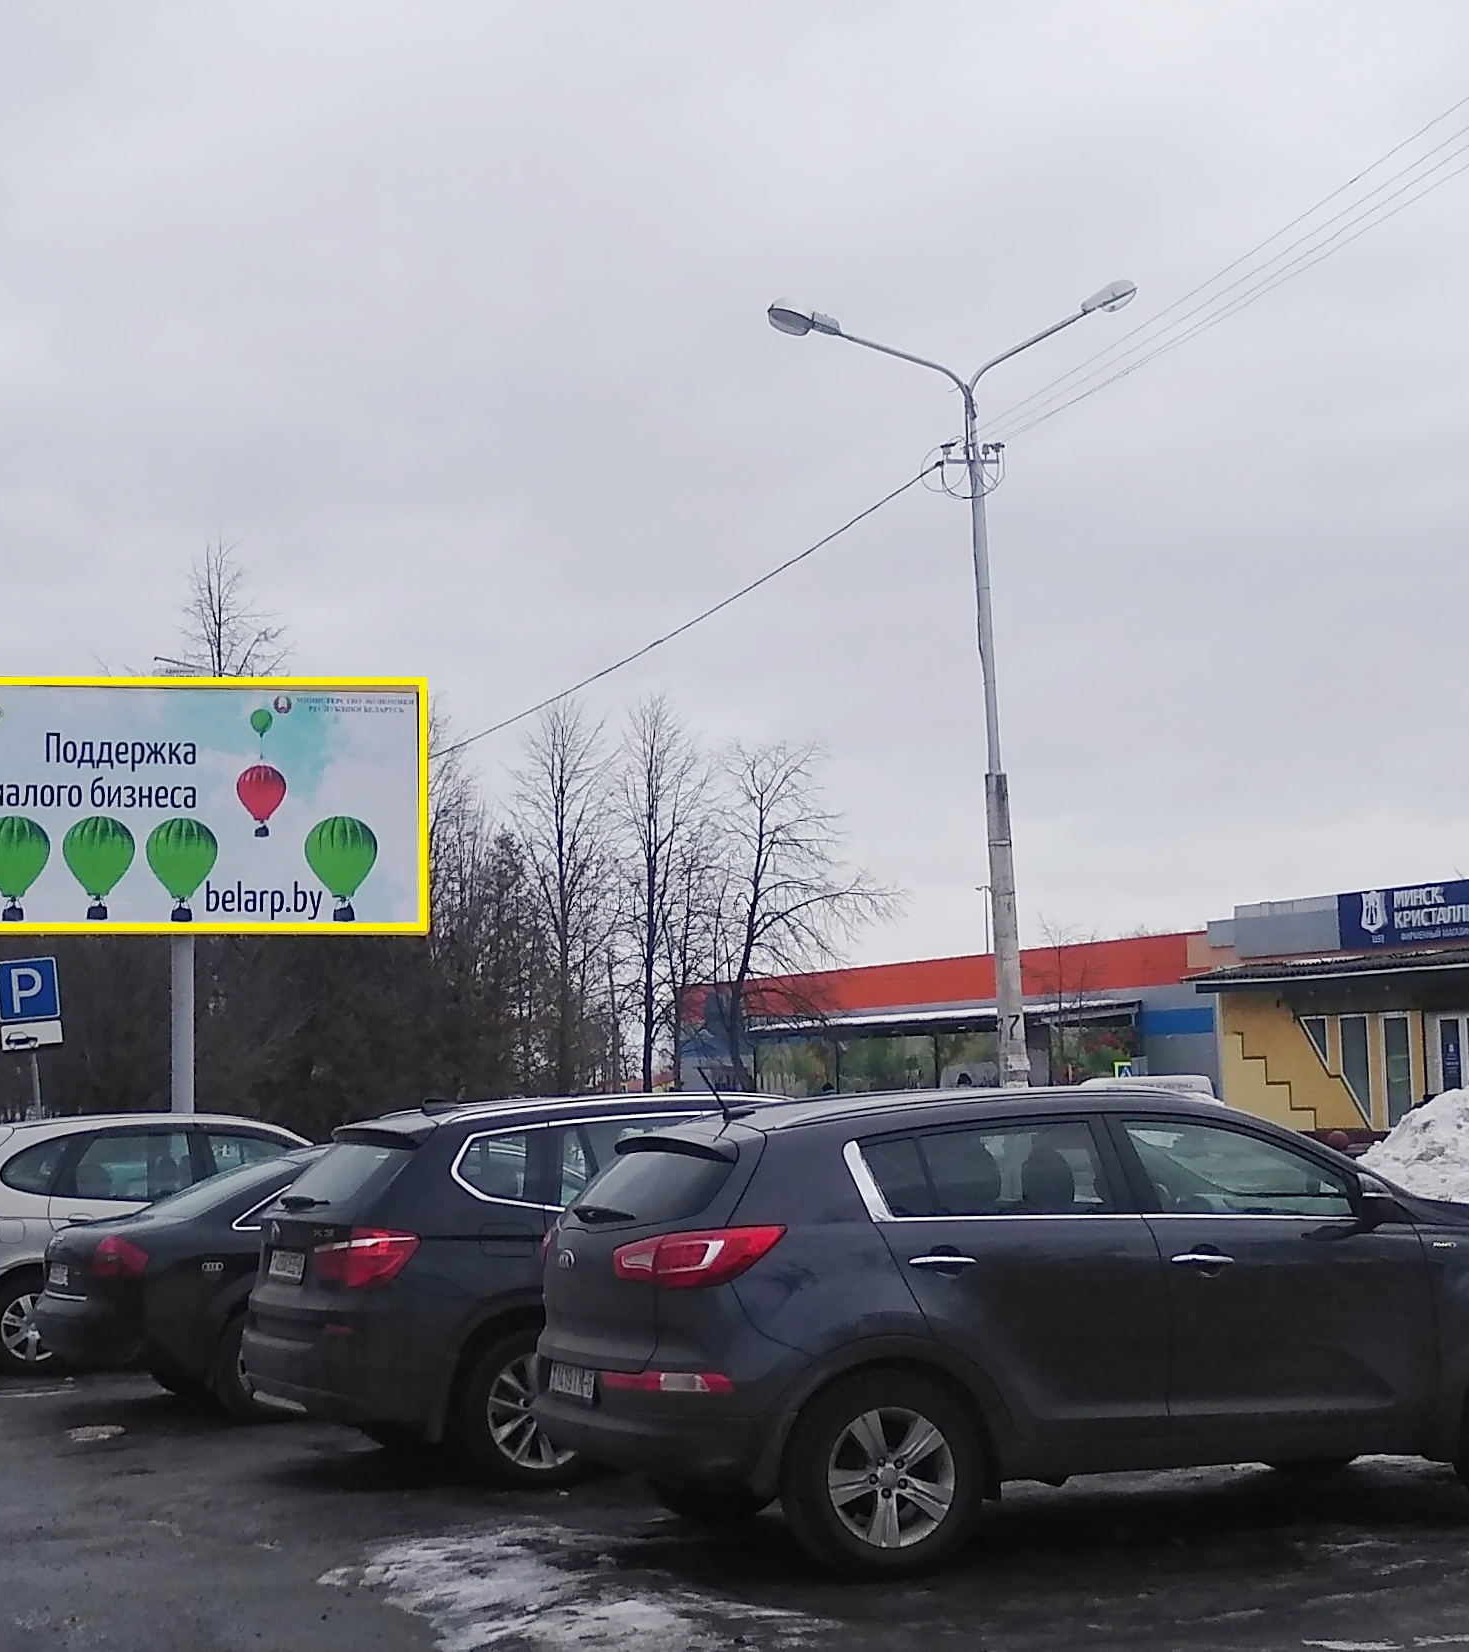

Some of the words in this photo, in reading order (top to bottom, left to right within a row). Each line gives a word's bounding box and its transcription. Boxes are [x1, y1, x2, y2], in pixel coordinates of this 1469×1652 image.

[45, 732, 197, 772] Поддержка
[90, 776, 197, 808] бизнеса
[206, 880, 323, 921] belarp.by
[1393, 886, 1445, 908] МИНСК
[1393, 904, 1469, 929] КРИСТАЛЛ
[10, 967, 42, 1014] P
